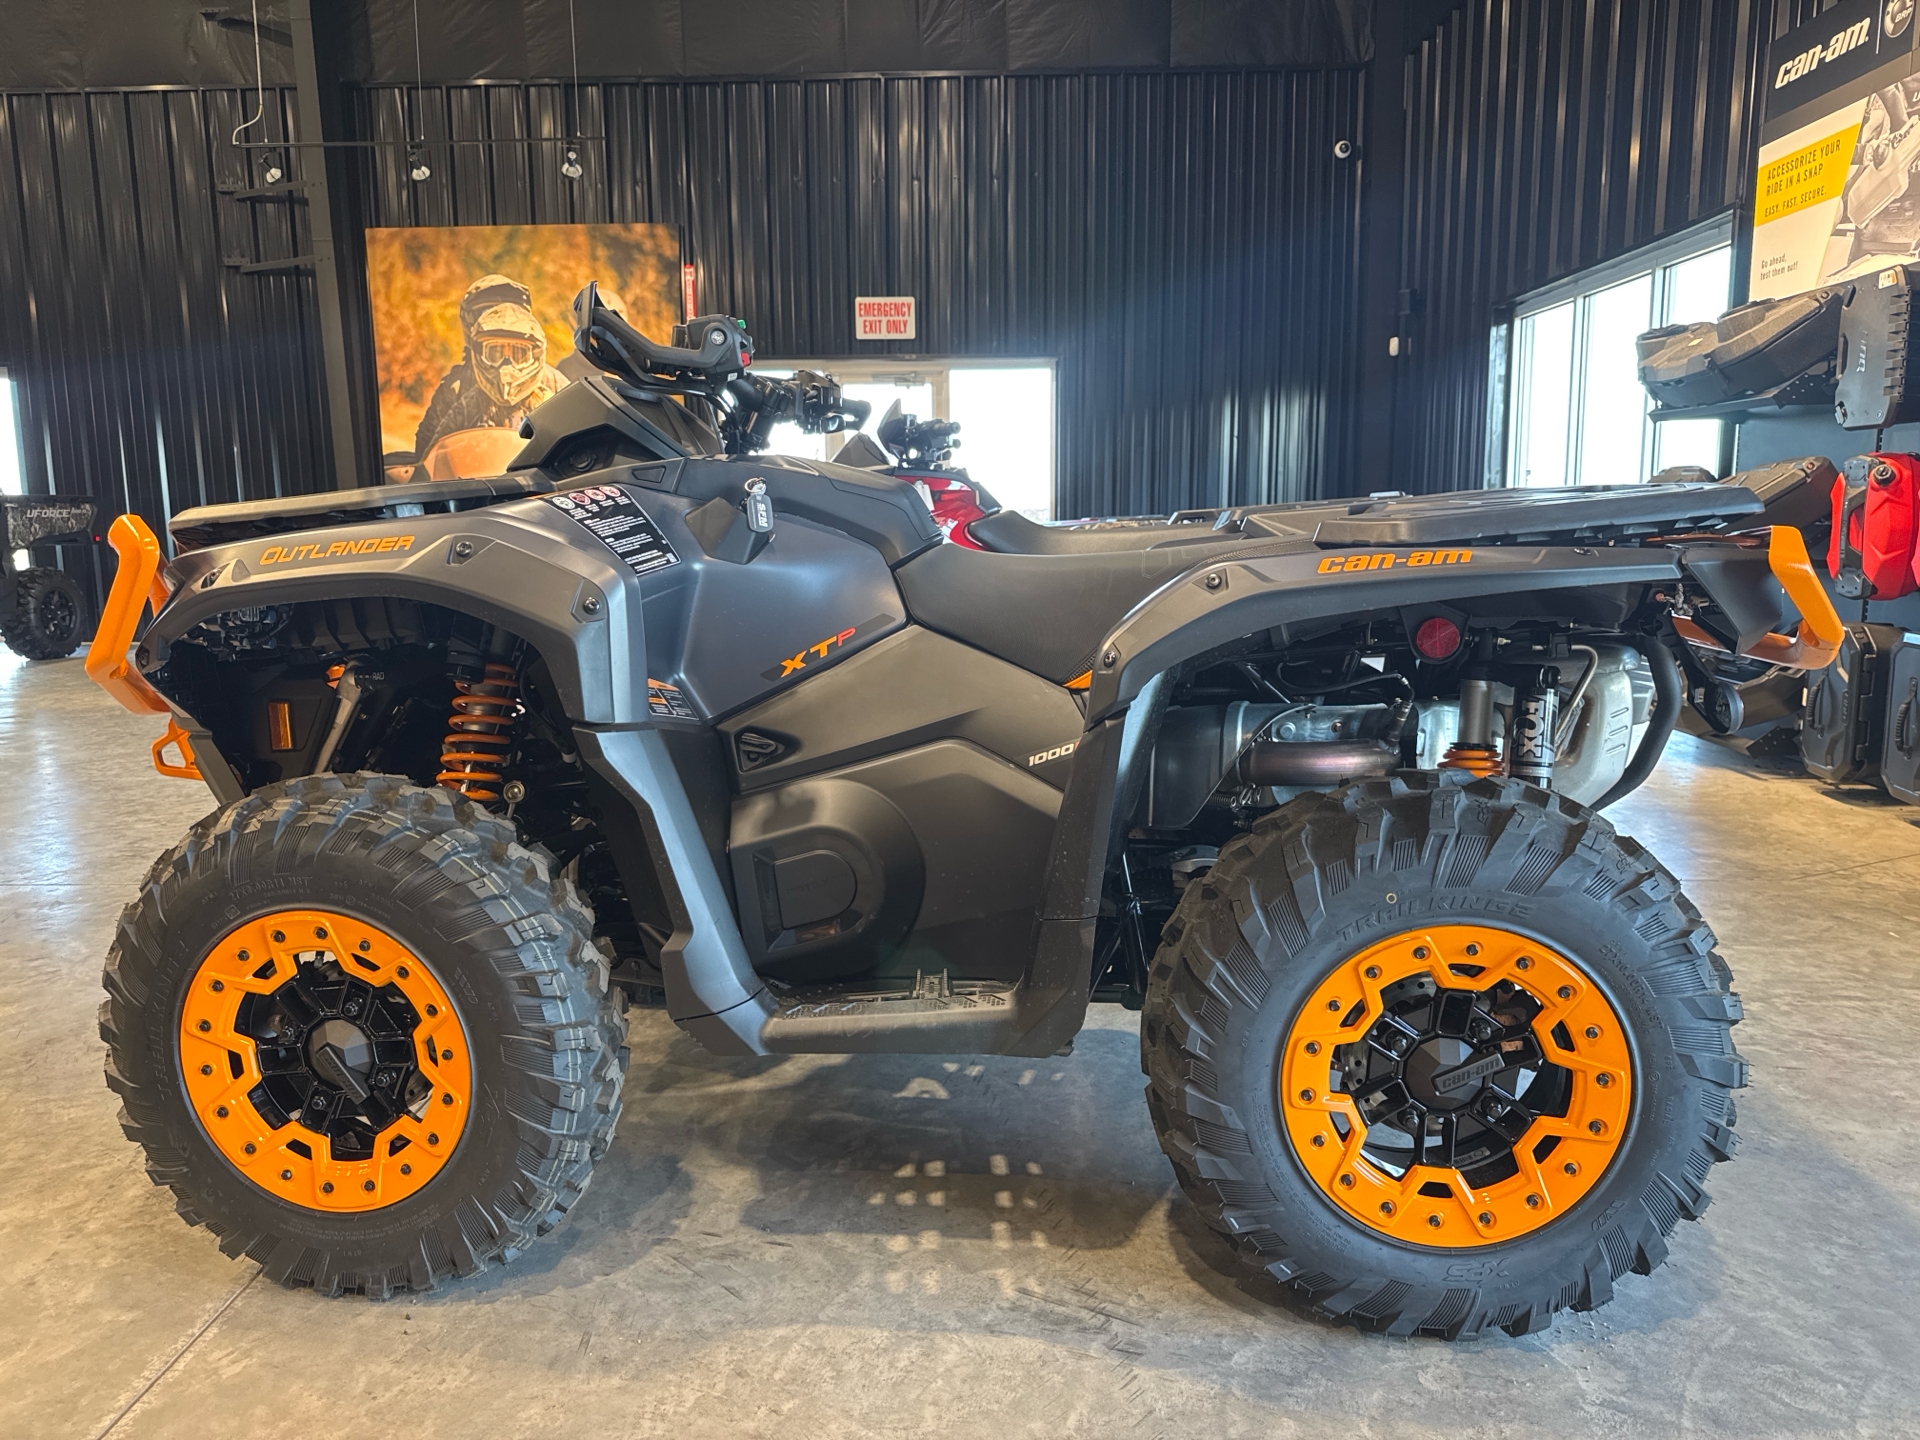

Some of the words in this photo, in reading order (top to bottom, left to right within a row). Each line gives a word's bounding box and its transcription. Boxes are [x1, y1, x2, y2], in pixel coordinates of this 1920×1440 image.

[1767, 150, 1817, 181] ACCESSORIZE
[1820, 139, 1841, 159] YOUR
[1766, 180, 1783, 197] RIDE
[1786, 175, 1794, 189] IN
[1796, 172, 1801, 185] A
[1803, 163, 1824, 181] SNAP
[1800, 185, 1826, 204] SECURE.
[1761, 260, 1768, 269] Go
[1769, 253, 1787, 267] ahead,
[858, 302, 912, 317] EMERGENCY
[863, 320, 882, 335] EXIT
[886, 320, 908, 335] ONLY
[26, 509, 71, 518] UFORCE
[259, 534, 416, 566] OUTLANDER
[1317, 550, 1474, 575] can-am
[780, 627, 857, 679] XTP
[1517, 700, 1545, 758] FOX
[1336, 899, 1421, 942] TRAIL
[1442, 1058, 1500, 1088] can-am
